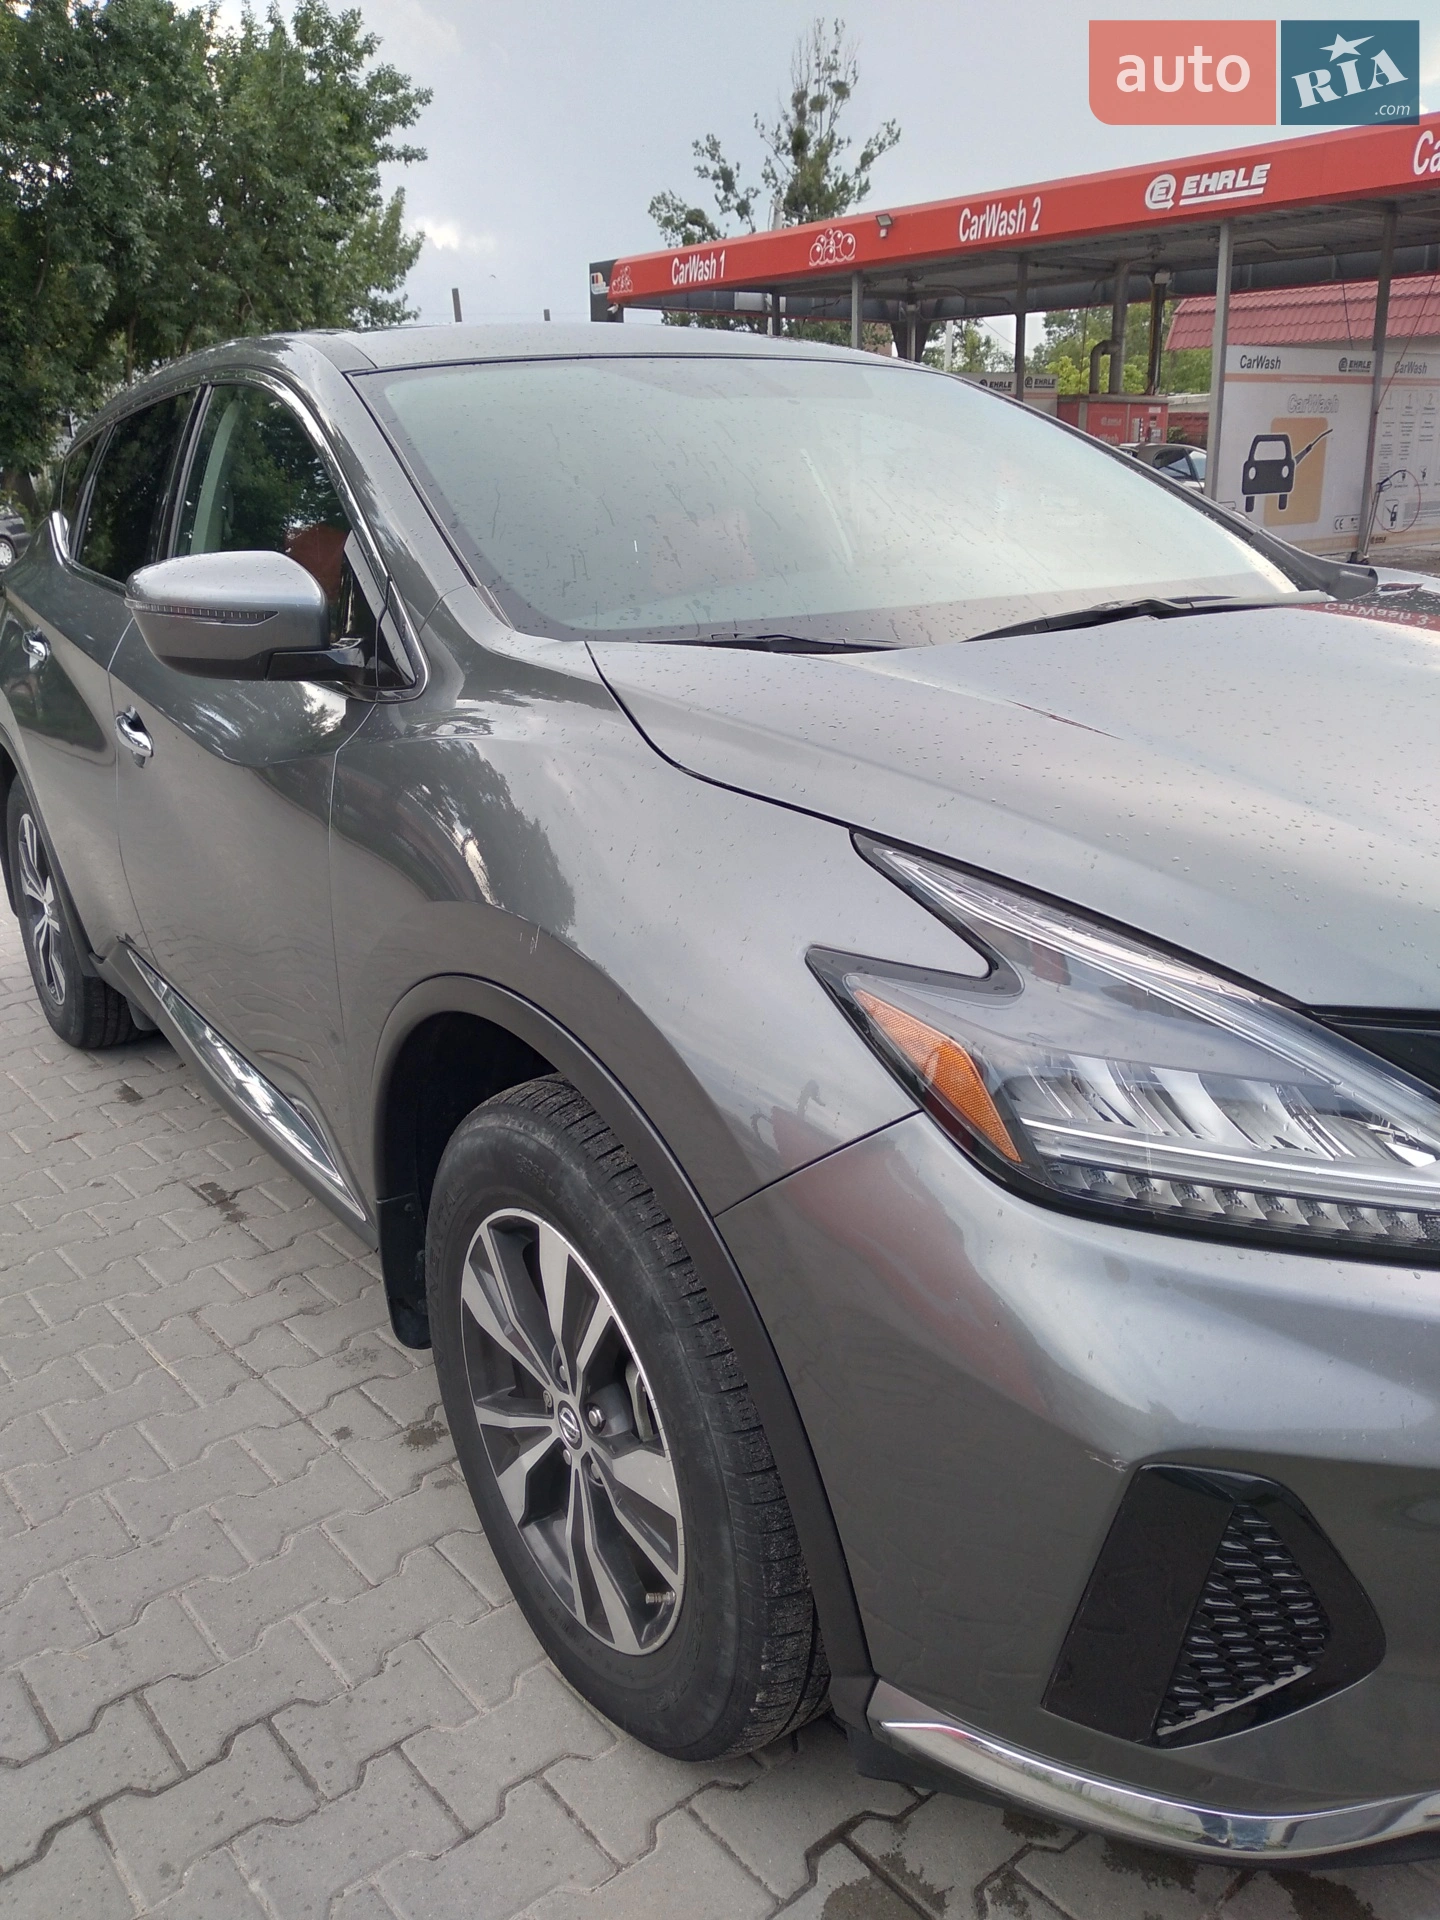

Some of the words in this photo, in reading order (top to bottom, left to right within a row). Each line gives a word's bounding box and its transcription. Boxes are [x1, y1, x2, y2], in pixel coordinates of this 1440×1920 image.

[1180, 163, 1271, 198] EHRLE
[959, 198, 1026, 242] CarWash
[1030, 196, 1042, 232] 2
[671, 251, 717, 286] CarWash
[719, 249, 726, 279] 1
[1240, 354, 1281, 370] CarWash
[1348, 360, 1372, 369] EHRLE
[1394, 360, 1428, 375] CarWash
[988, 381, 1013, 389] EHRLE
[1034, 378, 1056, 386] EHRLE
[1287, 393, 1340, 414] CarWash
